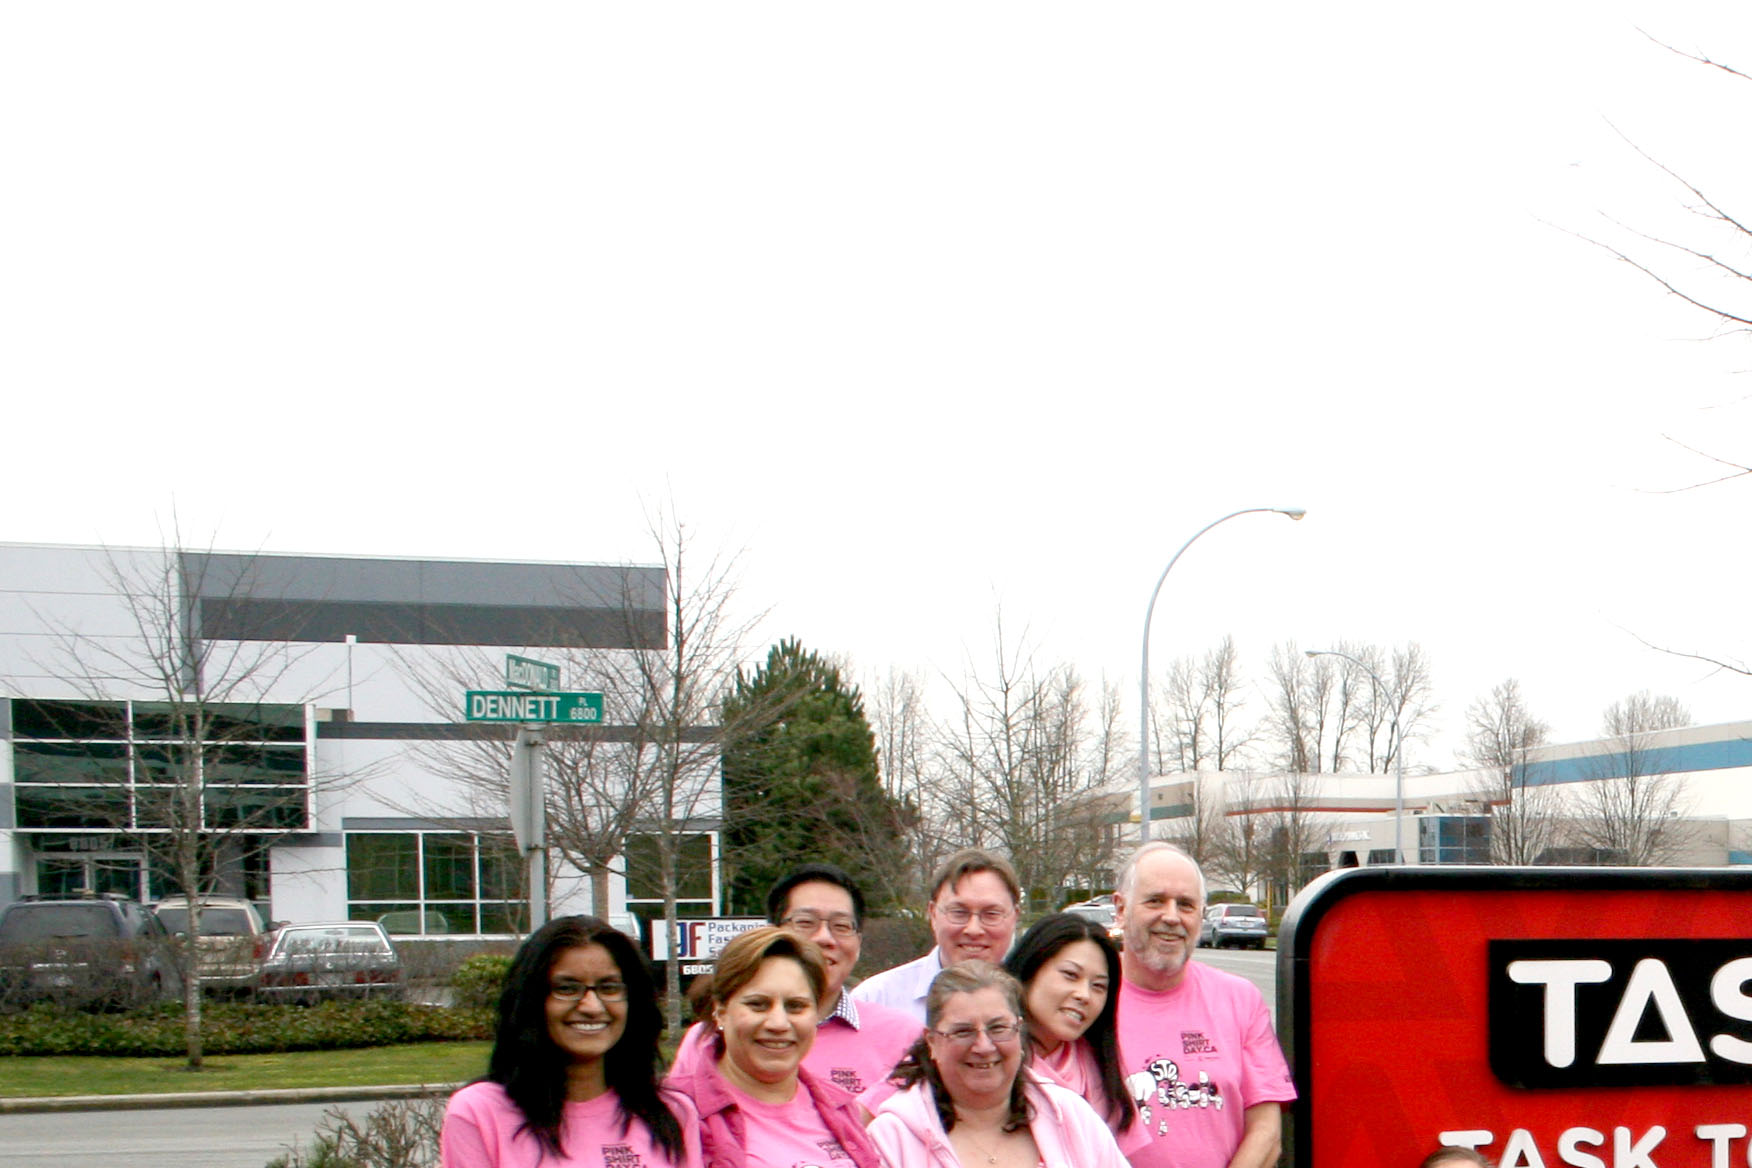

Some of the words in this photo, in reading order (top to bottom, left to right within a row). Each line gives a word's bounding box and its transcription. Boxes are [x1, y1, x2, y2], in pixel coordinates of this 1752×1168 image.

[472, 695, 561, 719] DENNETT
[570, 707, 597, 719] 6800
[682, 964, 713, 975] 6805
[602, 1146, 634, 1155] PINK
[604, 1154, 641, 1164] SHIRT
